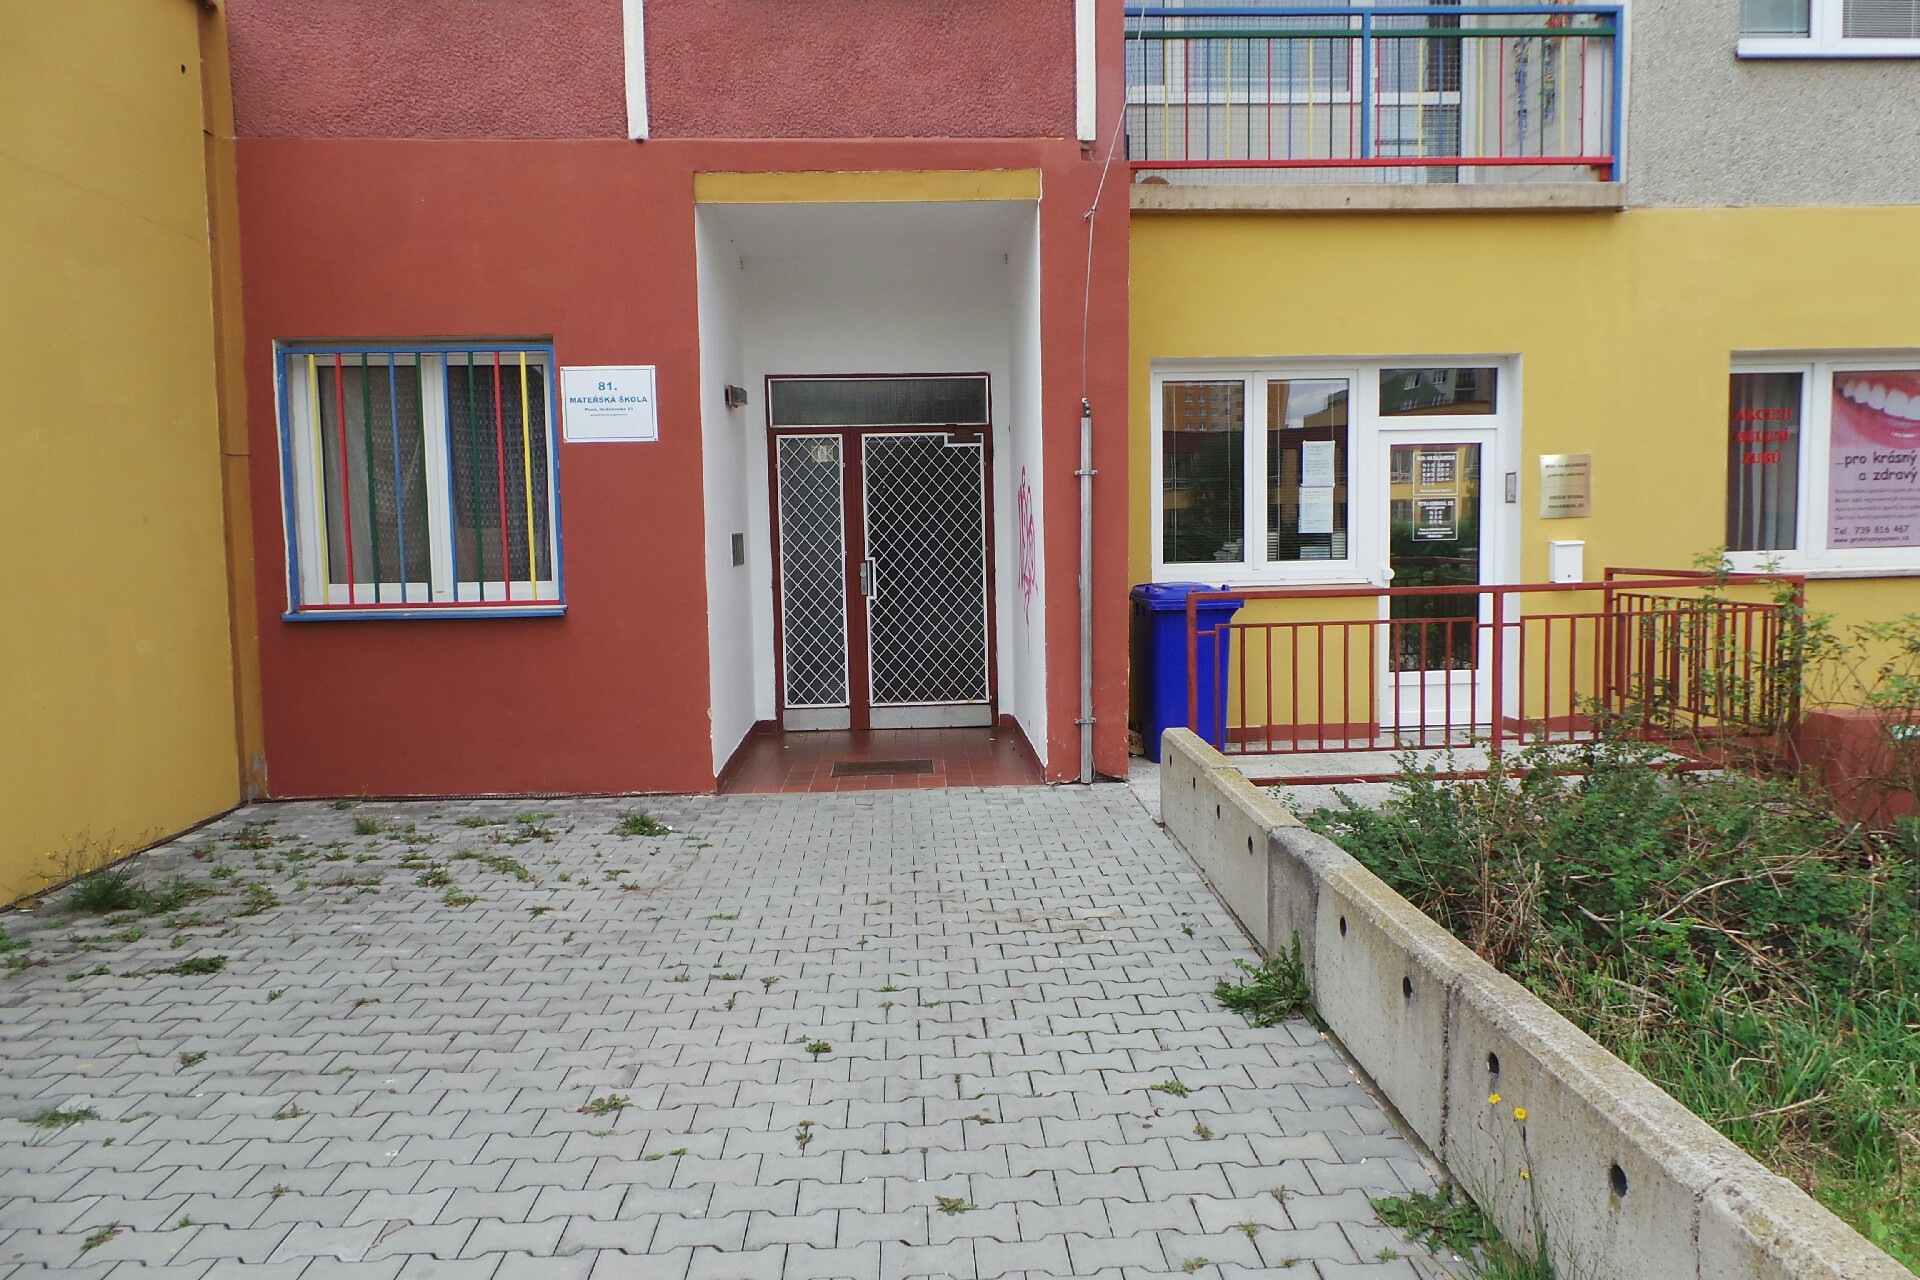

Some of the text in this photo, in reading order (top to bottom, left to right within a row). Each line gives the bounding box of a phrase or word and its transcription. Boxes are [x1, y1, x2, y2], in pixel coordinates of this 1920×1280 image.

[598, 381, 617, 391] 81.
[569, 394, 648, 404] MATEŘSKÁ ŠKOLA
[1873, 450, 1918, 467] krásný
[1858, 467, 1919, 484] a zdravý
[1854, 526, 1871, 535] 739
[1893, 524, 1910, 534] 467
